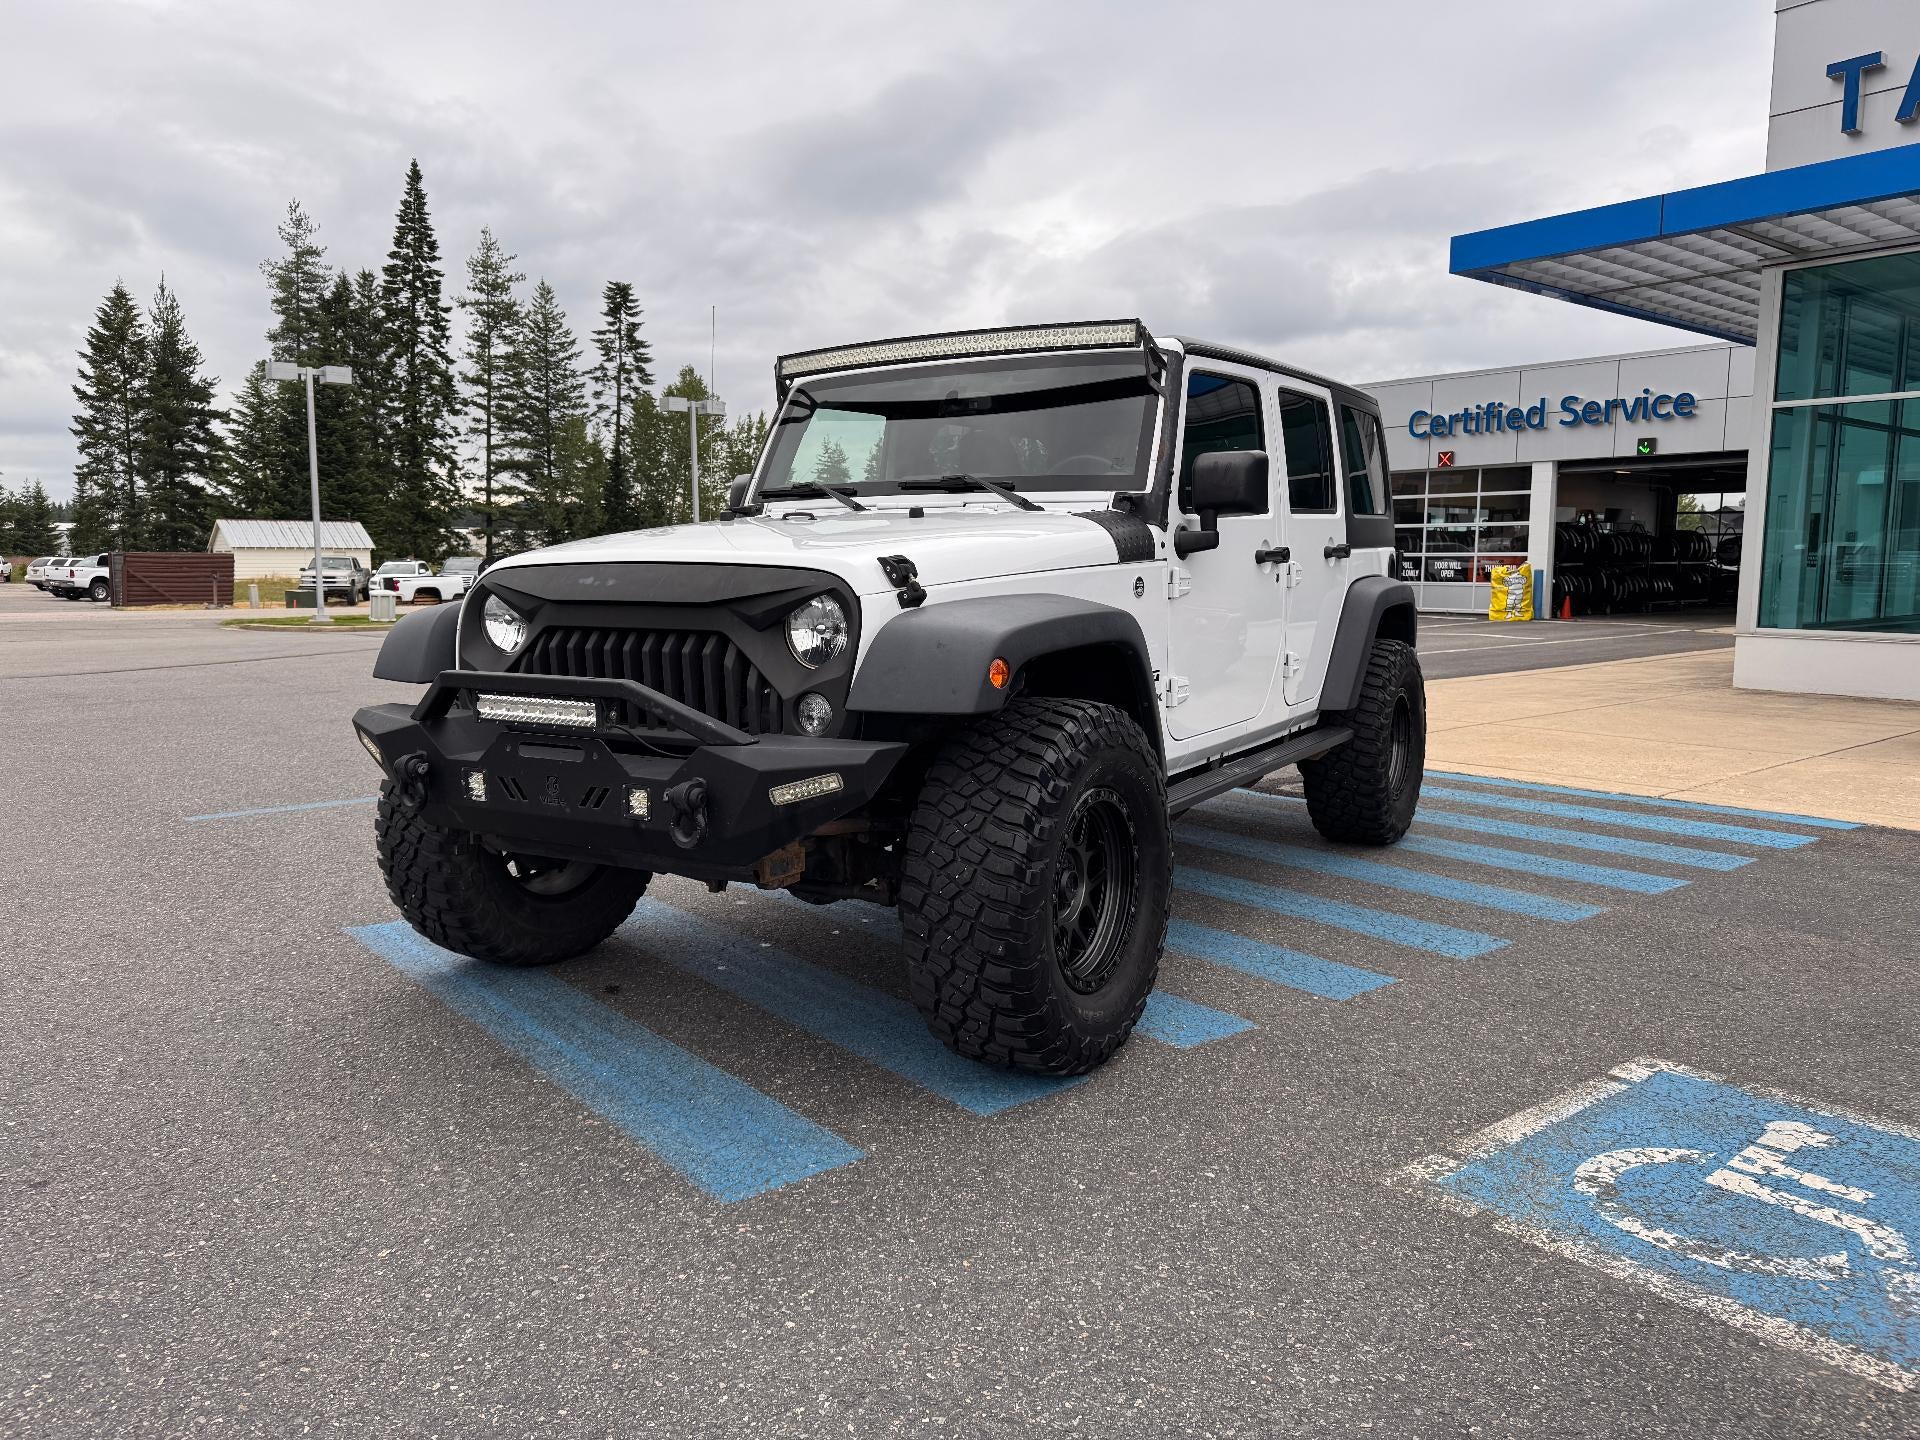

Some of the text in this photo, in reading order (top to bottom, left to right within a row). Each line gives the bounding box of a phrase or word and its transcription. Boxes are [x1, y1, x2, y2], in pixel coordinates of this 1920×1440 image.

[1826, 51, 1920, 136] T
[1408, 388, 1697, 440] Certified Service
[1434, 561, 1462, 570] DOOR WILL
[1440, 569, 1455, 578] OPEN
